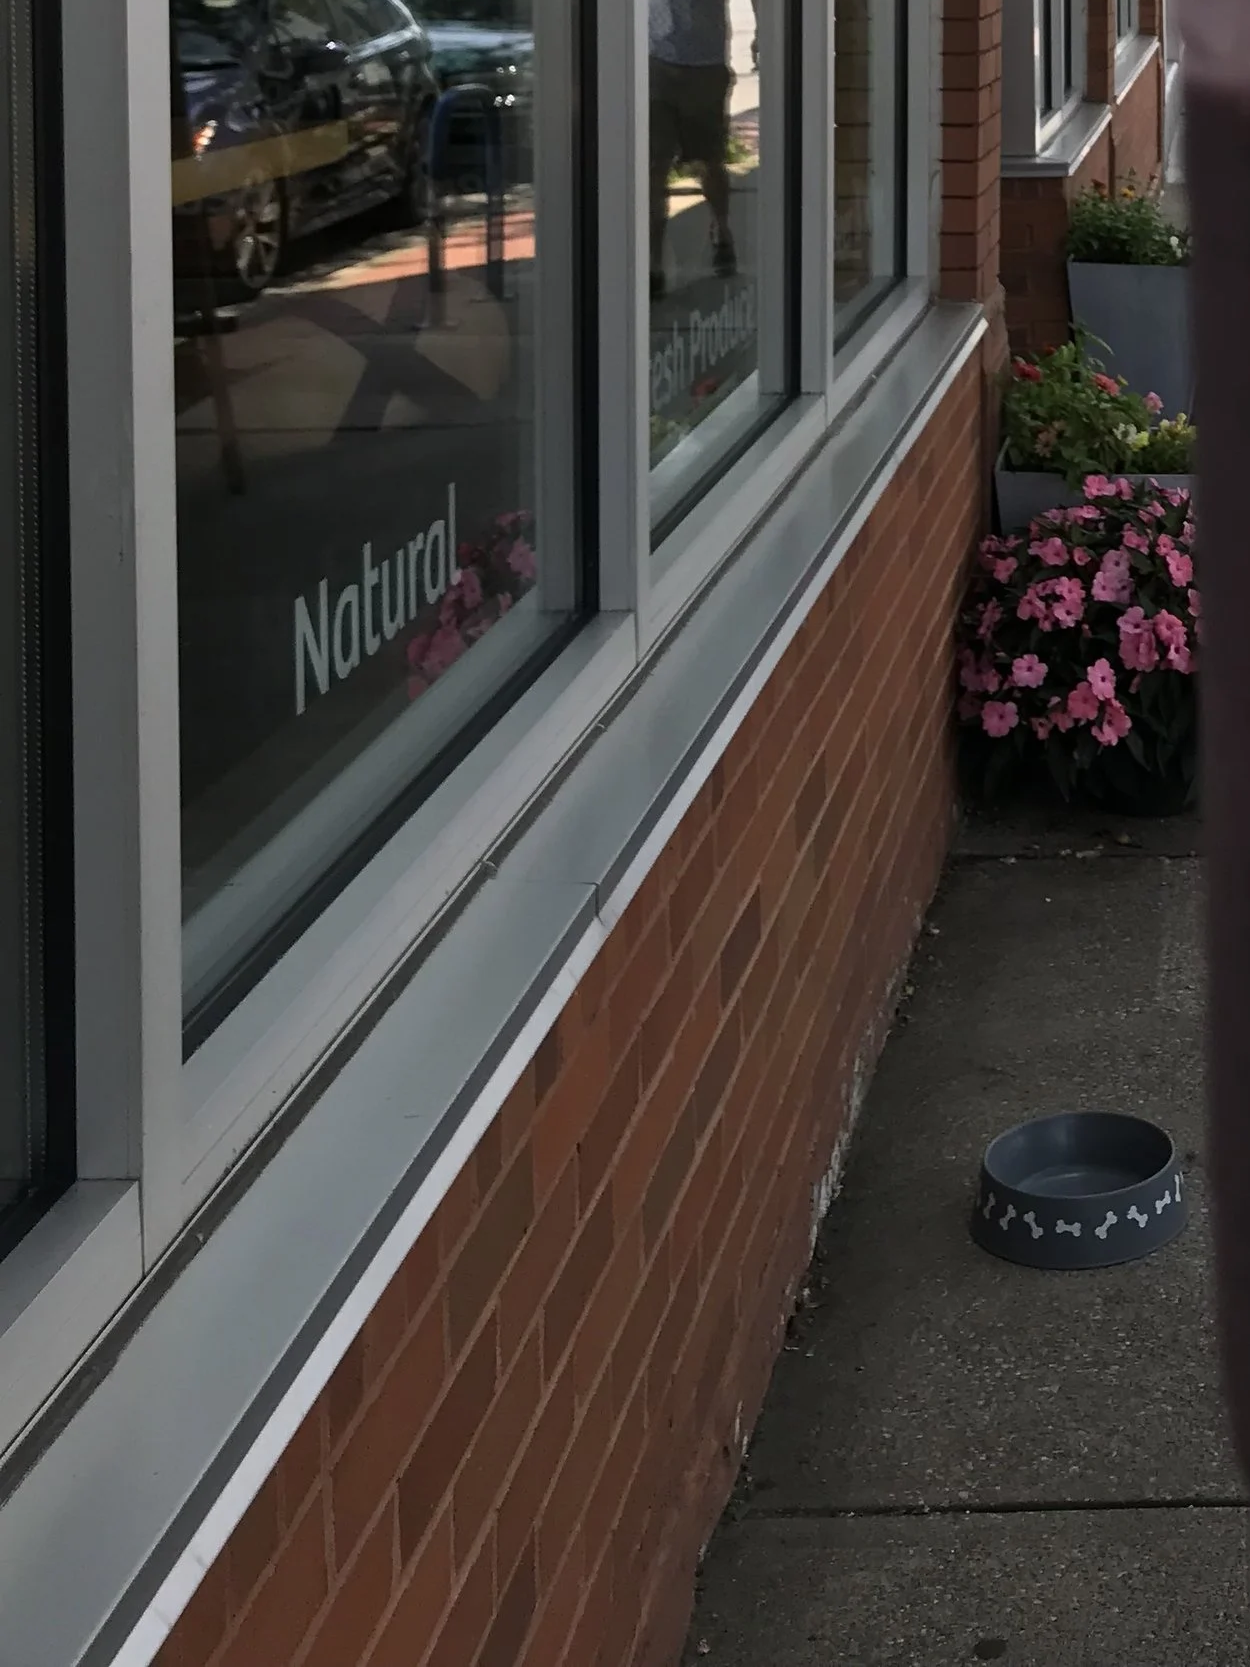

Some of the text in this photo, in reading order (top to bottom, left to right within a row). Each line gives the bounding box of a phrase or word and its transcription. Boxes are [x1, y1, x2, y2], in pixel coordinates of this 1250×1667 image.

[649, 283, 756, 411] esh Produce
[294, 482, 460, 715] Natural
